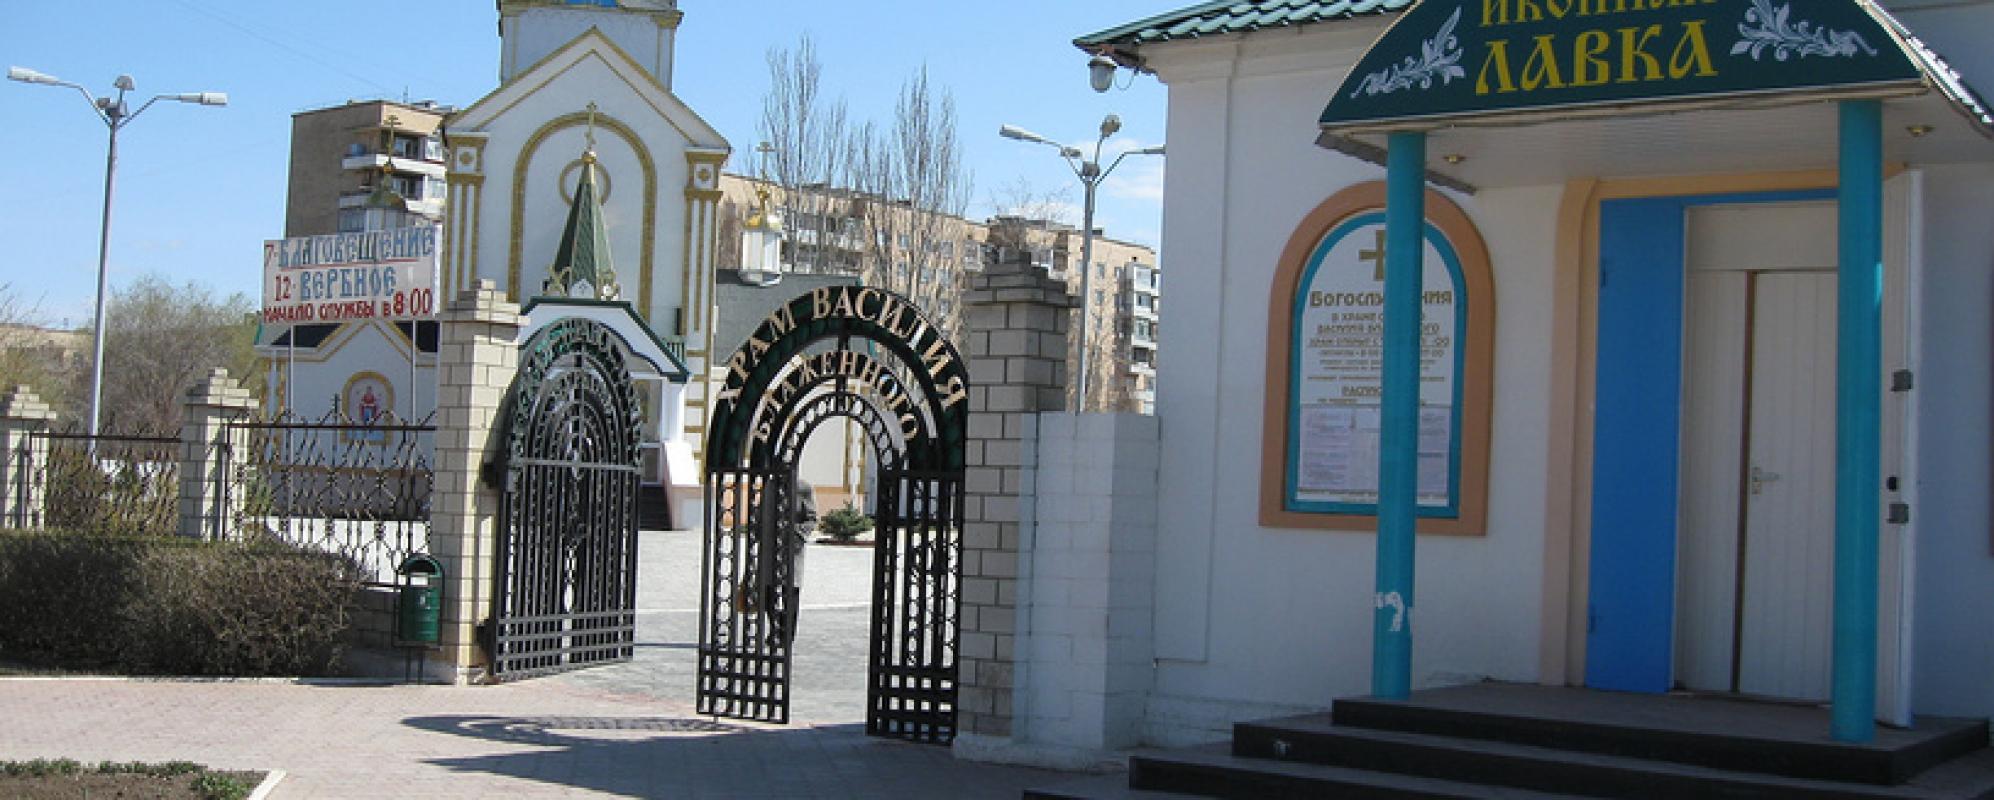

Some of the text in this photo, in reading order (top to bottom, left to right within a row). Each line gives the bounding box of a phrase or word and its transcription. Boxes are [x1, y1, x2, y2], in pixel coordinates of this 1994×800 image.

[1475, 19, 1719, 96] ЛАВКА
[264, 302, 314, 323] НАЧАЛО
[319, 300, 375, 321] СЛУЖБЫ
[301, 266, 397, 300] ВЕРБНОЕ
[717, 302, 799, 413] ХРАМ
[812, 286, 967, 410] ВАСИЛИЯ
[752, 351, 919, 444] БЛАЖЕННОГО
